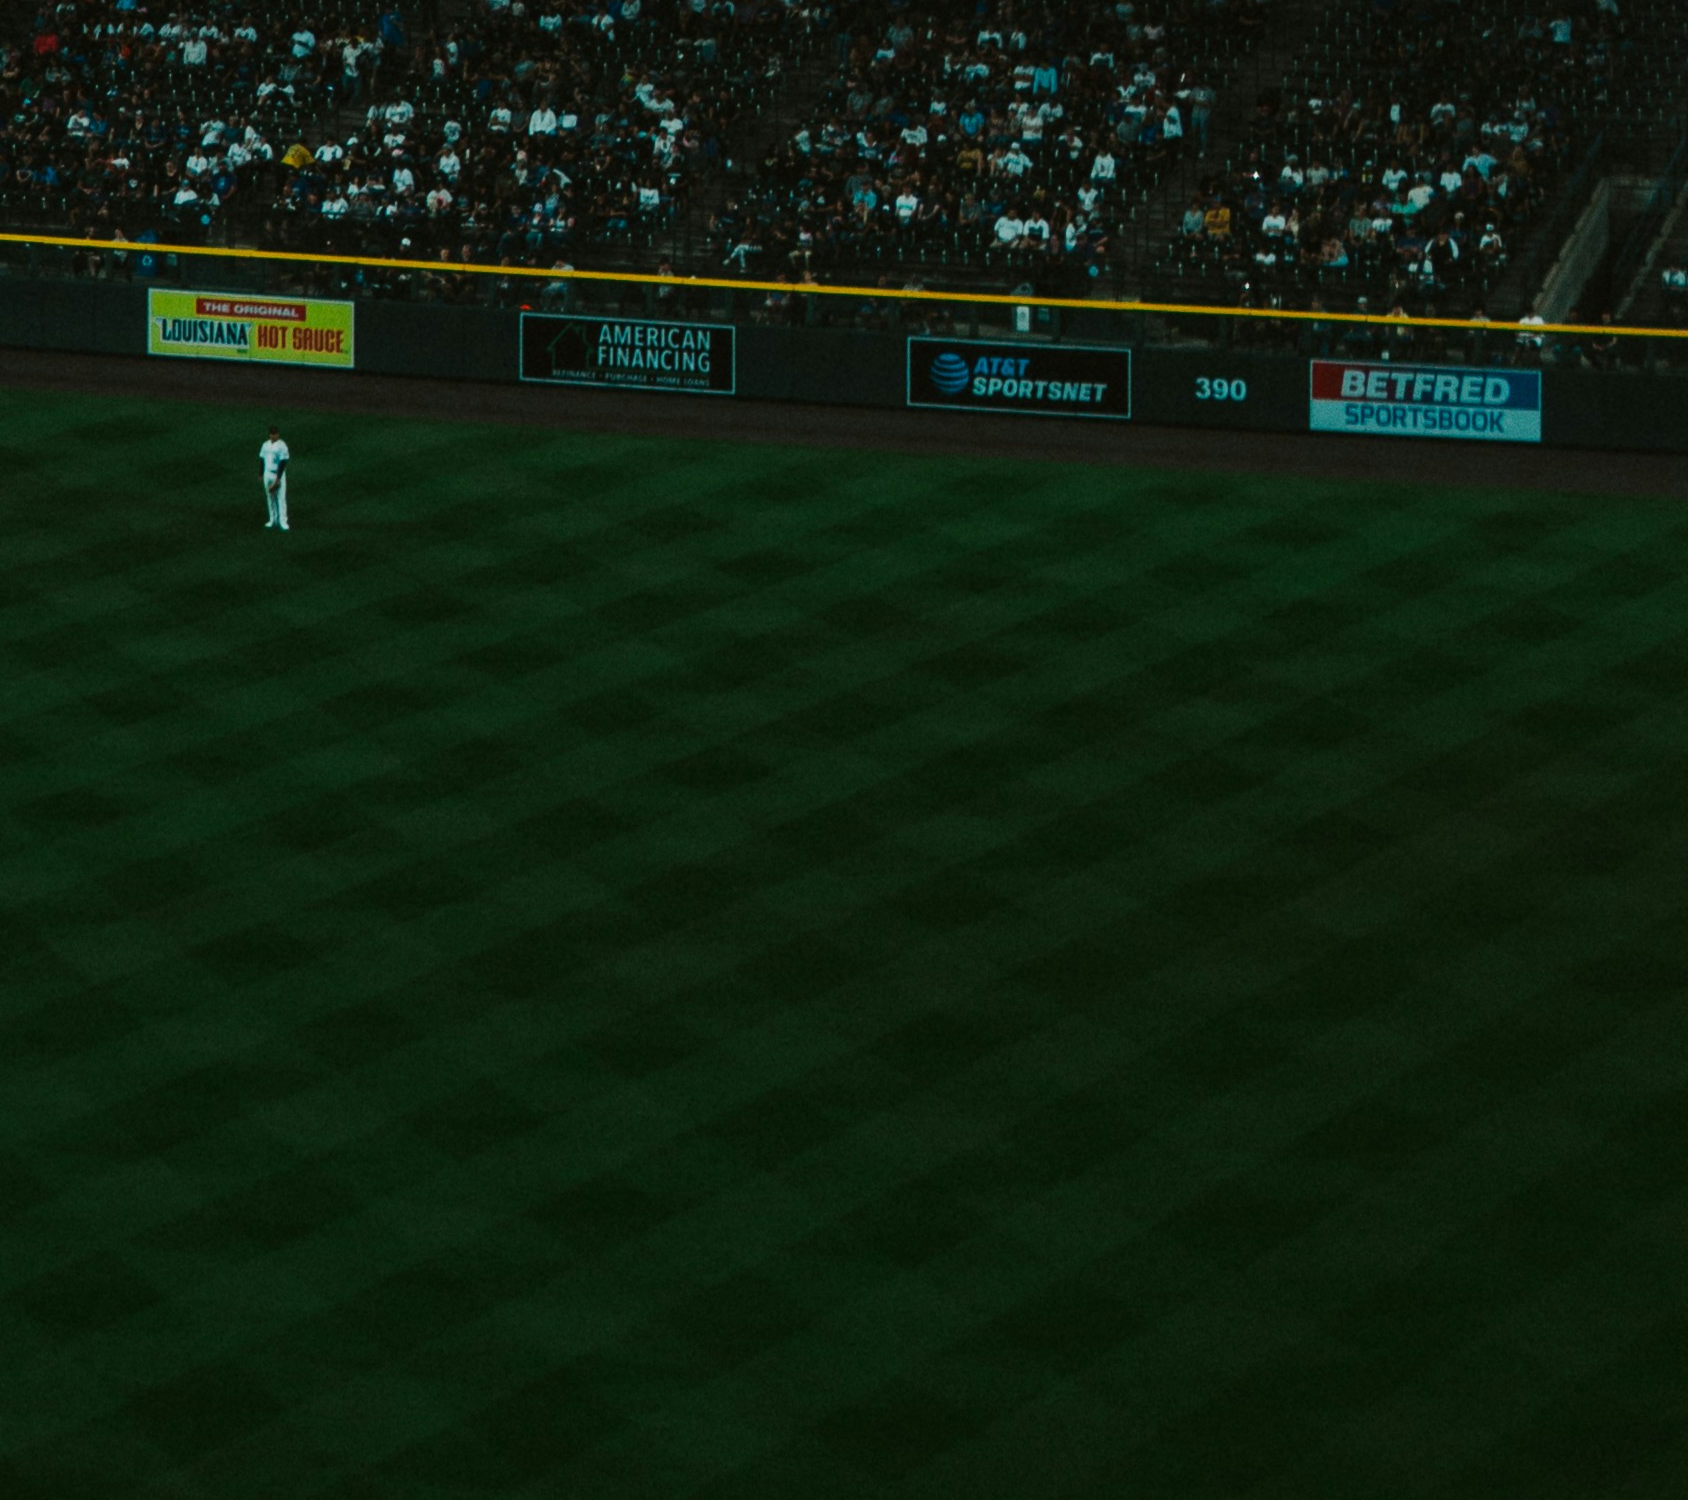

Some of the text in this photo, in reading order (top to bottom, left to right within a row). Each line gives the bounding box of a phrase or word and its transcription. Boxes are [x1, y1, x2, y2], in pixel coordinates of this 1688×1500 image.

[203, 301, 299, 318] THE ORIGINAL
[161, 318, 345, 354] LOUISIANA HOT SAUCE
[597, 323, 711, 351] AMERICAN
[596, 345, 711, 374] FINANCING
[972, 355, 1032, 378] AT&T
[971, 377, 1109, 404] SPORTSNET
[1194, 376, 1249, 403] 390
[1340, 369, 1512, 405] BETFRED
[1343, 402, 1505, 434] SPORTSBOOK
